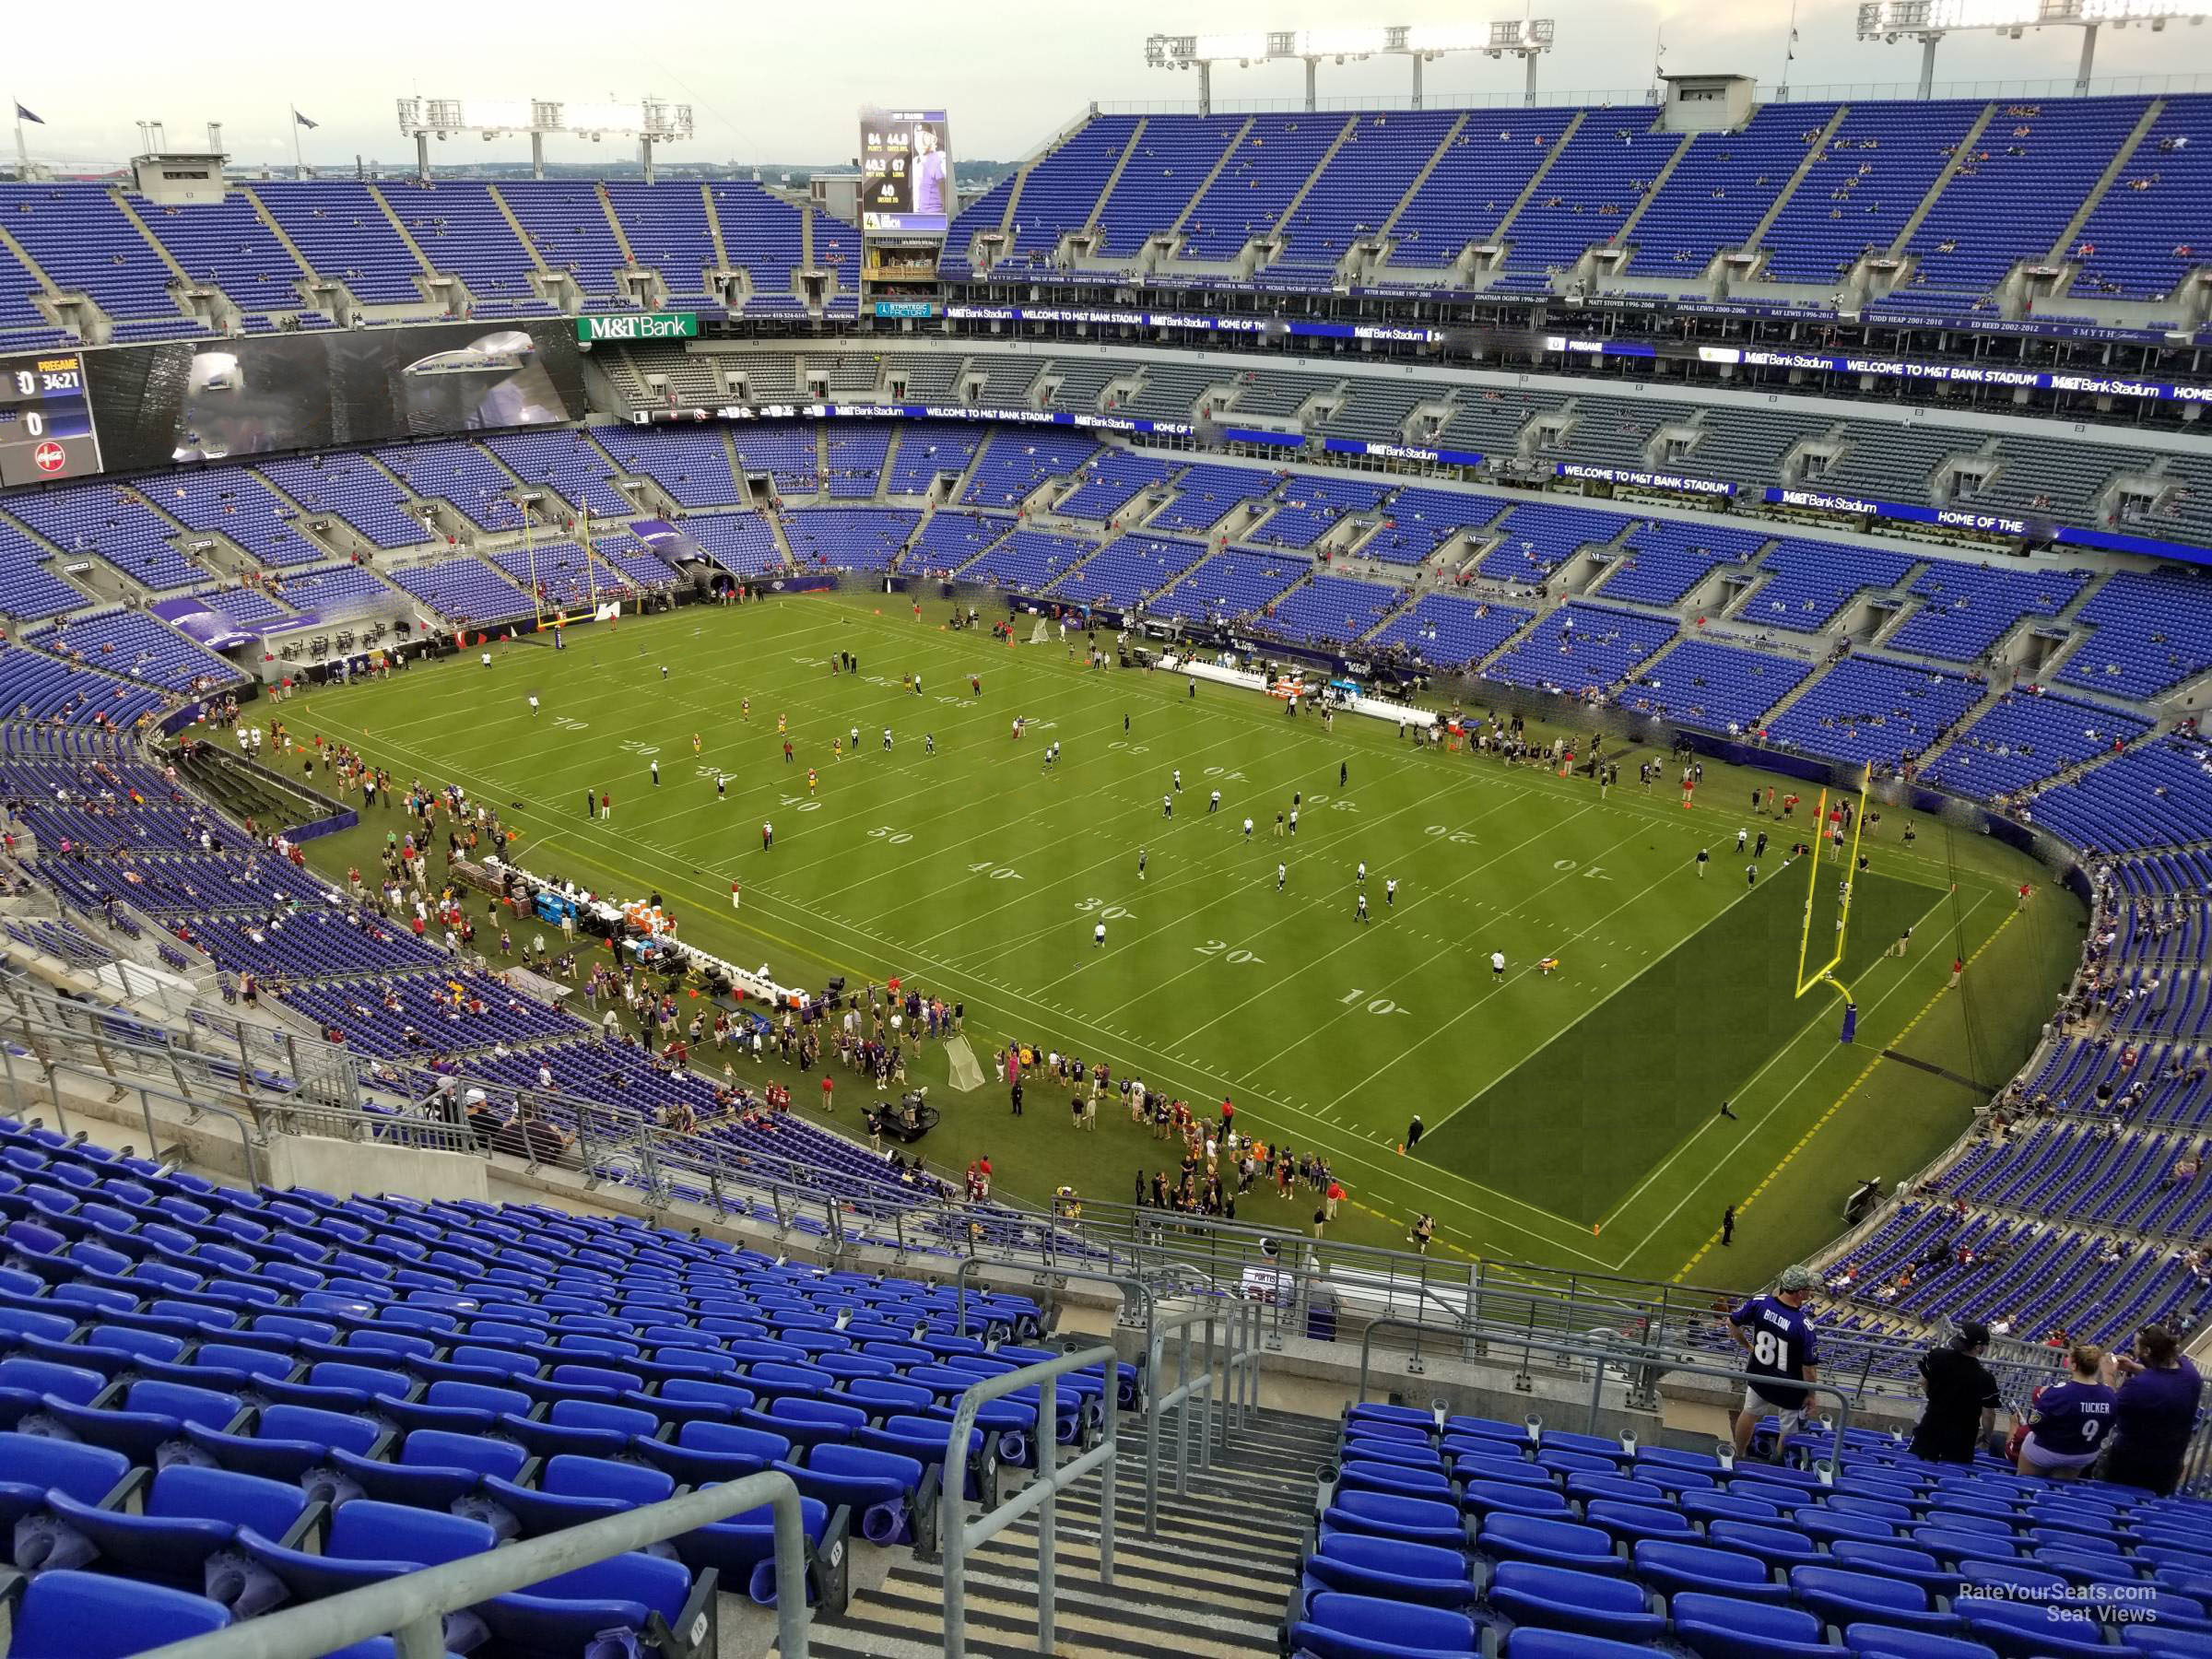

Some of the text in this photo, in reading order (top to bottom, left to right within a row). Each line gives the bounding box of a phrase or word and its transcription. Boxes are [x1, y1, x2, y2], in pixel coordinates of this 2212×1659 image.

[881, 184, 895, 197] 40
[966, 308, 983, 318] Bank
[983, 309, 1012, 318] Stadium
[1022, 310, 1142, 323] WELCOME TO M&T BANK STADIUM
[1715, 306, 1746, 314] 2000-2006
[589, 315, 686, 339] M&T Bank
[1167, 317, 1183, 327] Bank
[1183, 318, 1210, 328] Stadium
[1218, 319, 1240, 329] HOME
[1241, 320, 1252, 330] OF
[1907, 317, 1942, 325] 2001-2010
[2001, 324, 2039, 332] 2002-2012
[1374, 329, 1392, 339] Bank
[1392, 330, 1423, 341] Stadium
[2073, 328, 2114, 338] SMYTH
[38, 359, 79, 372] PREGAME
[1745, 352, 1833, 369] M&T Bank Stadium
[1847, 360, 2038, 385] WELCOME TO M&T BANK STADIUM
[42, 372, 79, 390] 34:21
[2051, 375, 2159, 397] M&T Bank Stadium
[2173, 387, 2212, 400] HOME
[855, 407, 873, 415] Bank
[873, 407, 903, 415] Stadium
[926, 407, 1053, 422] WELCOME TO M&T BANK STADIUM
[27, 412, 43, 435] 0
[1092, 417, 1107, 427] Bank
[1108, 418, 1135, 429] Stadium
[1153, 423, 1175, 433] HOME
[1177, 424, 1187, 433] OF
[1387, 445, 1406, 457] Bank
[1406, 447, 1437, 460] Stadium
[1565, 465, 1729, 493] WELCOME TO M&T BANK STADIUM
[1783, 491, 1877, 514] M&T Bank Stadium
[1938, 511, 2024, 533] HOME OF THE
[557, 717, 589, 730] 10
[619, 740, 660, 756] 20
[695, 765, 738, 782] 30
[780, 794, 821, 812] 40
[867, 826, 913, 845] 50
[967, 861, 1016, 879] 40
[1074, 897, 1128, 920] 30
[1193, 939, 1253, 965] 20
[1336, 988, 1398, 1015] 10
[1254, 1273, 1276, 1283] PORTIS
[1764, 1309, 1791, 1332] BOLDIN
[1754, 1331, 1788, 1372] 81
[2080, 1402, 2109, 1414] TUCKER
[2082, 1419, 2099, 1442] 9
[833, 1545, 840, 1559] 15
[694, 1622, 704, 1638] 16
